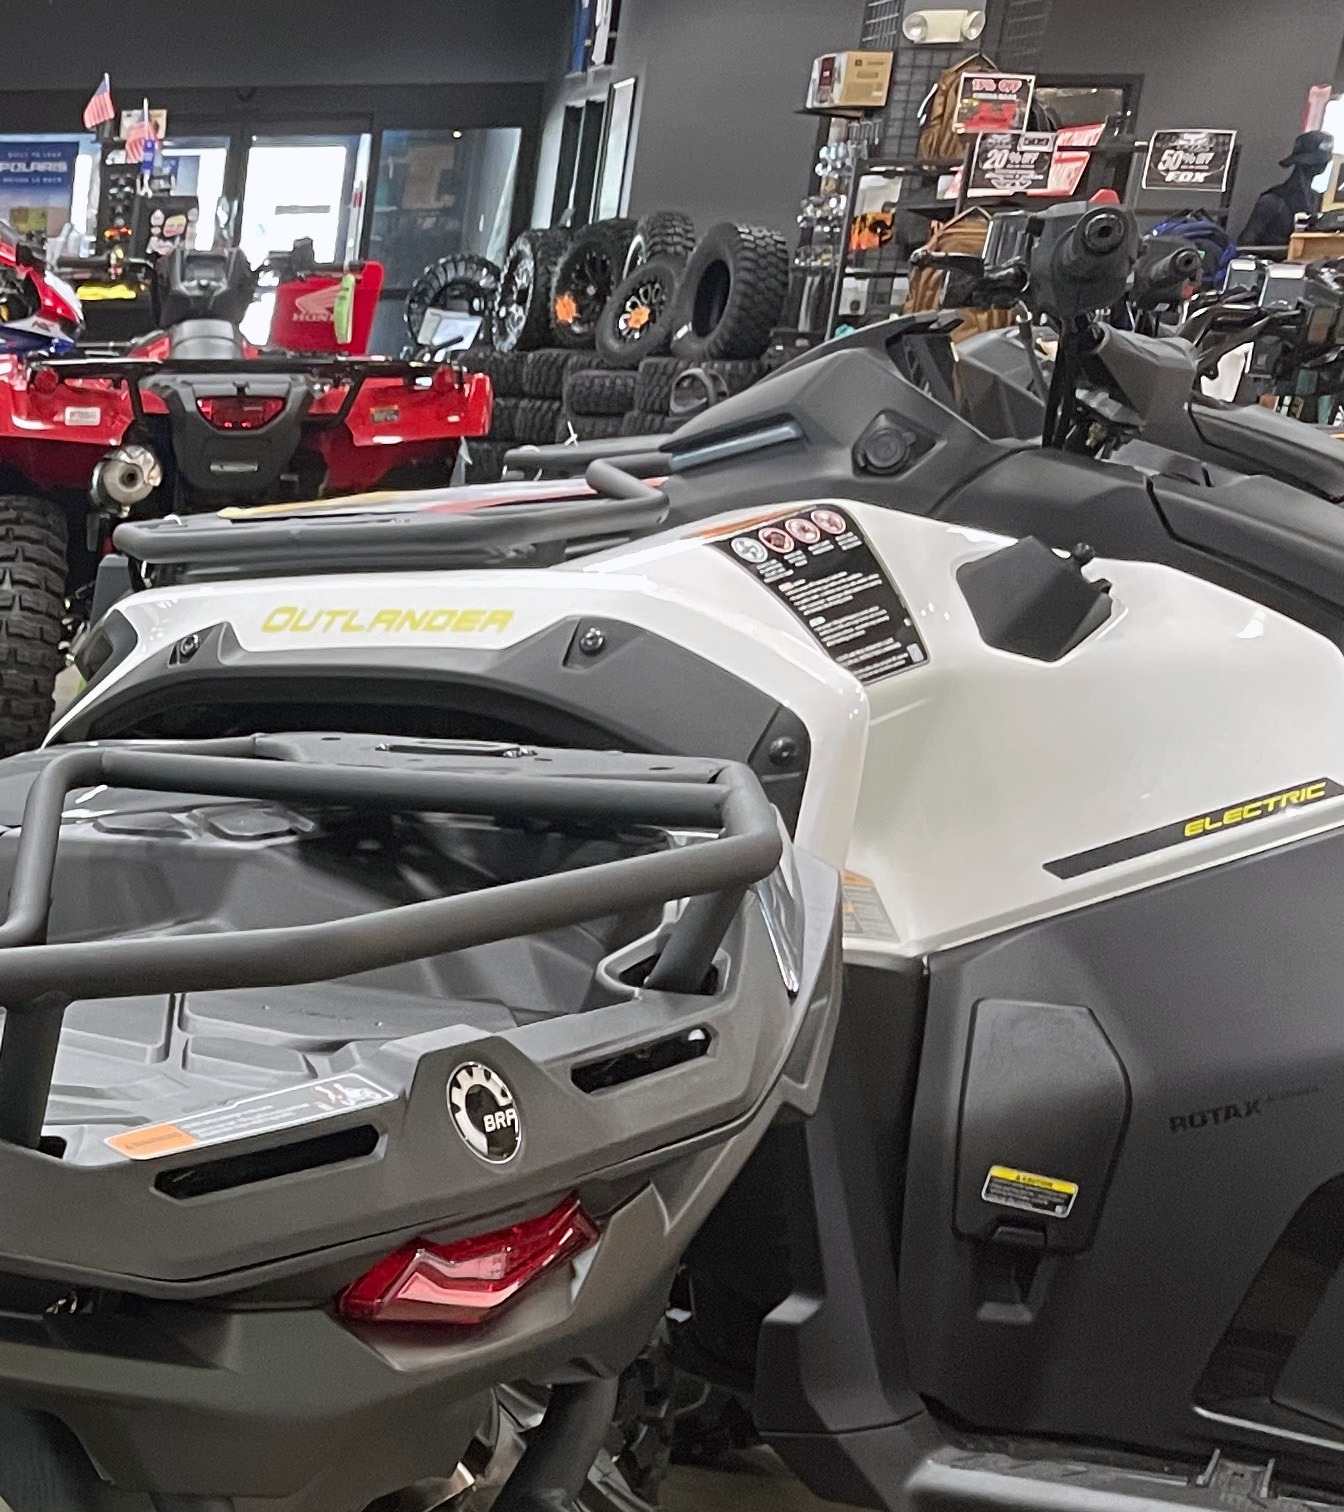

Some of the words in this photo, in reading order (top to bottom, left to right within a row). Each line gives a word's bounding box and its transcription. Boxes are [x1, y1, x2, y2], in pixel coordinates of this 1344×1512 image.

[1164, 171, 1209, 183] FOX
[261, 606, 515, 633] OUTLANDER
[1184, 781, 1327, 837] ELECTRIC
[483, 1108, 516, 1133] BRP
[1169, 1099, 1261, 1132] ROTAX
